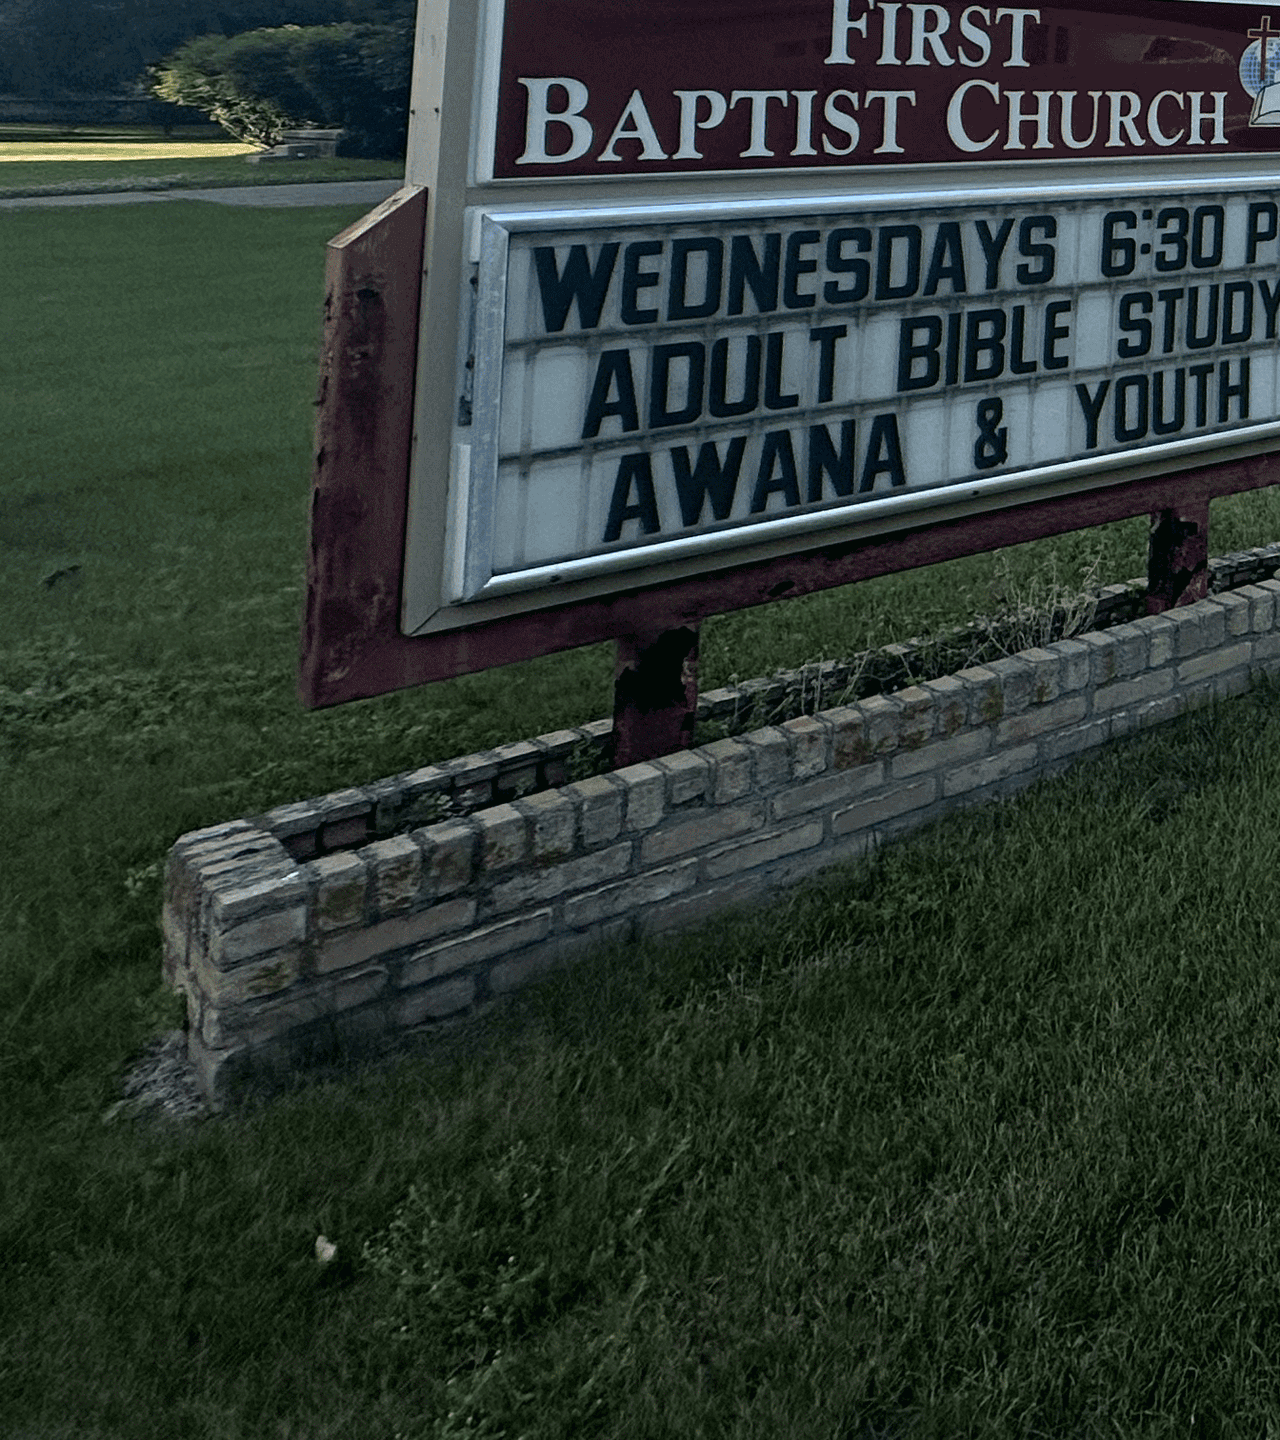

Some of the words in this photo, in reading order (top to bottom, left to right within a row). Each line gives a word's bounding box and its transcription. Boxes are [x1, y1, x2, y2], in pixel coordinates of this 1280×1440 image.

[515, 77, 916, 164] BAPTIST
[947, 79, 1229, 152] CHURCH
[534, 215, 1057, 333] WEDNESDAYS
[1101, 205, 1224, 278] 6:30
[581, 325, 847, 439] ADULT
[897, 300, 1072, 392] BIBLE
[603, 413, 906, 542] AWANA
[974, 397, 1008, 469] &
[1075, 357, 1250, 449] YOUTH
